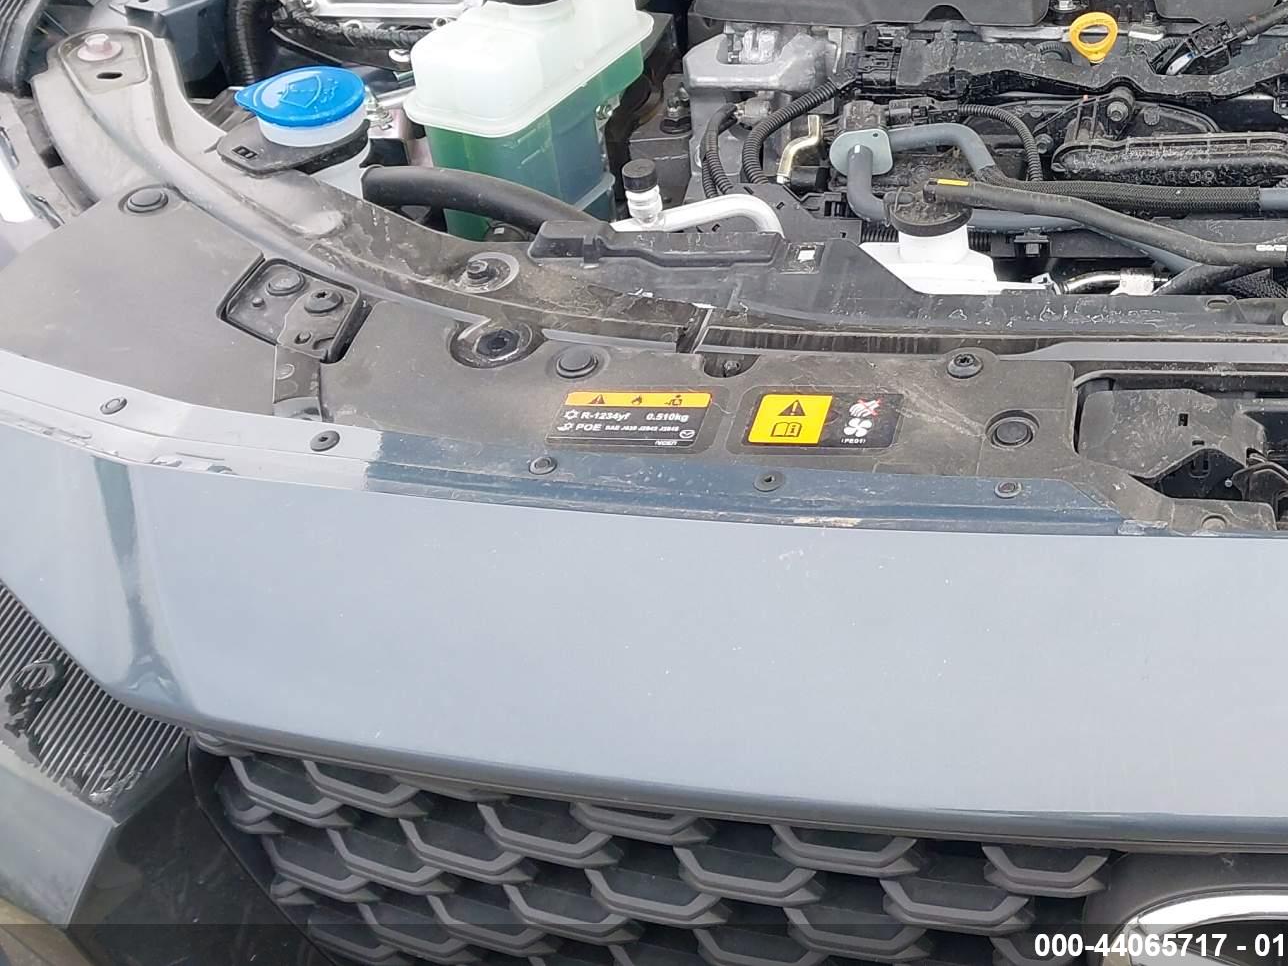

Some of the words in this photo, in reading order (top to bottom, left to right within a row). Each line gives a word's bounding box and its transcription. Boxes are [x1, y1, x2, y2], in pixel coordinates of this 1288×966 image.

[580, 411, 632, 422] R-1234yf
[646, 413, 690, 423] 0.510kg
[575, 423, 602, 431] POE
